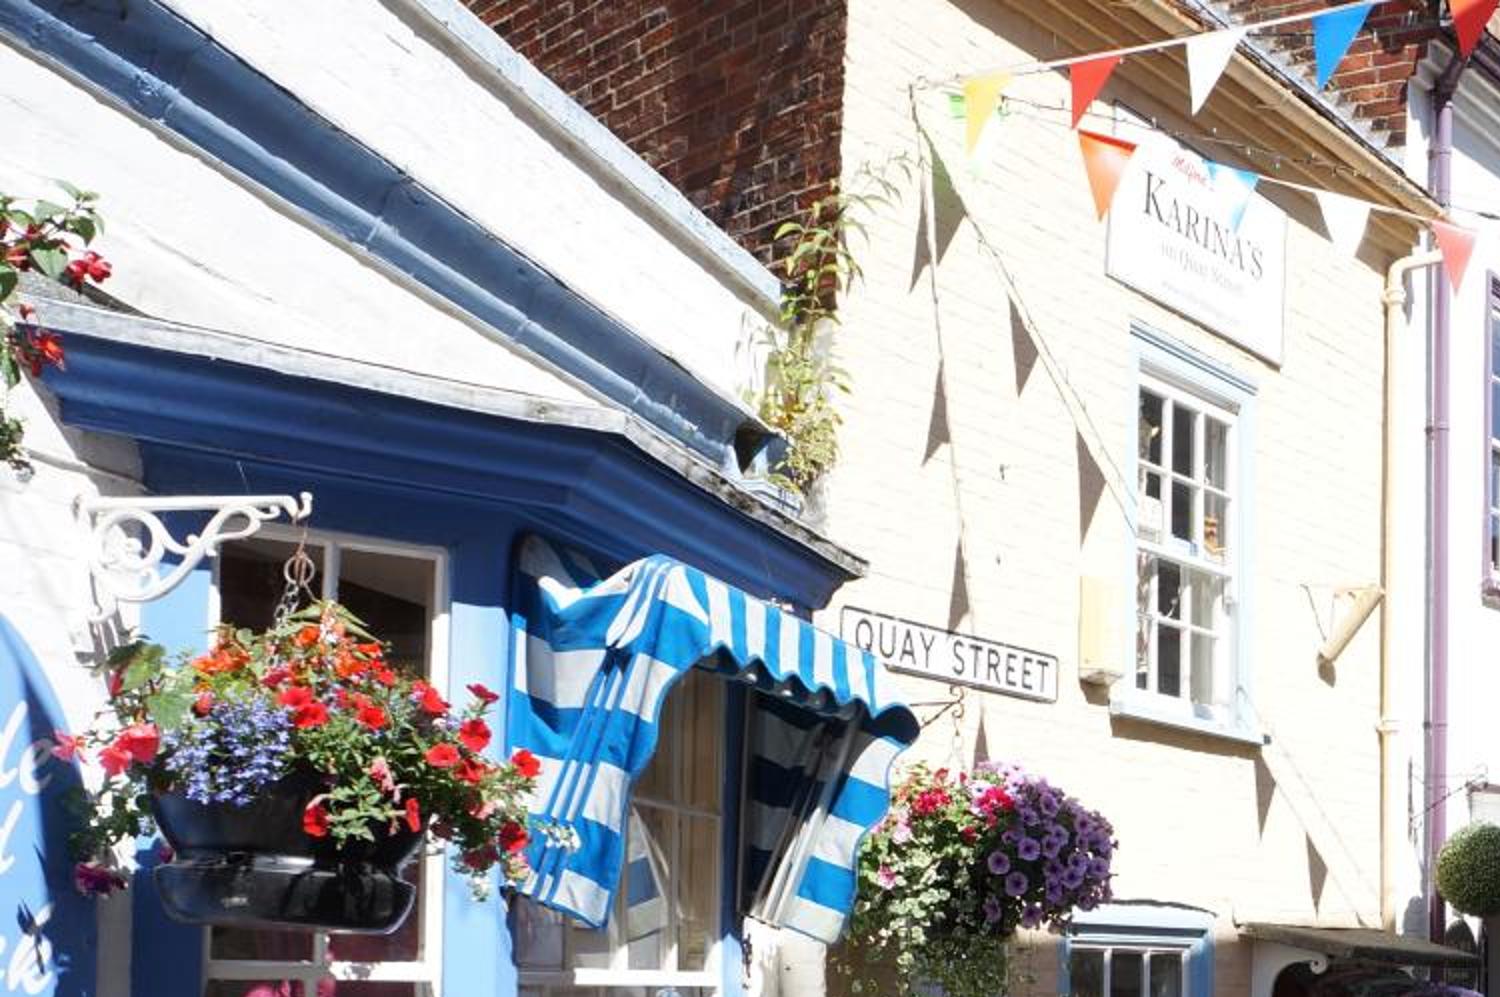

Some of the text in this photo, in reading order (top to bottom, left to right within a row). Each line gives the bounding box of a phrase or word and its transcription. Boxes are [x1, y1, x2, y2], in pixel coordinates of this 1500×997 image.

[1143, 171, 1263, 281] KARINA'S
[855, 618, 1049, 693] QUAY STREET
